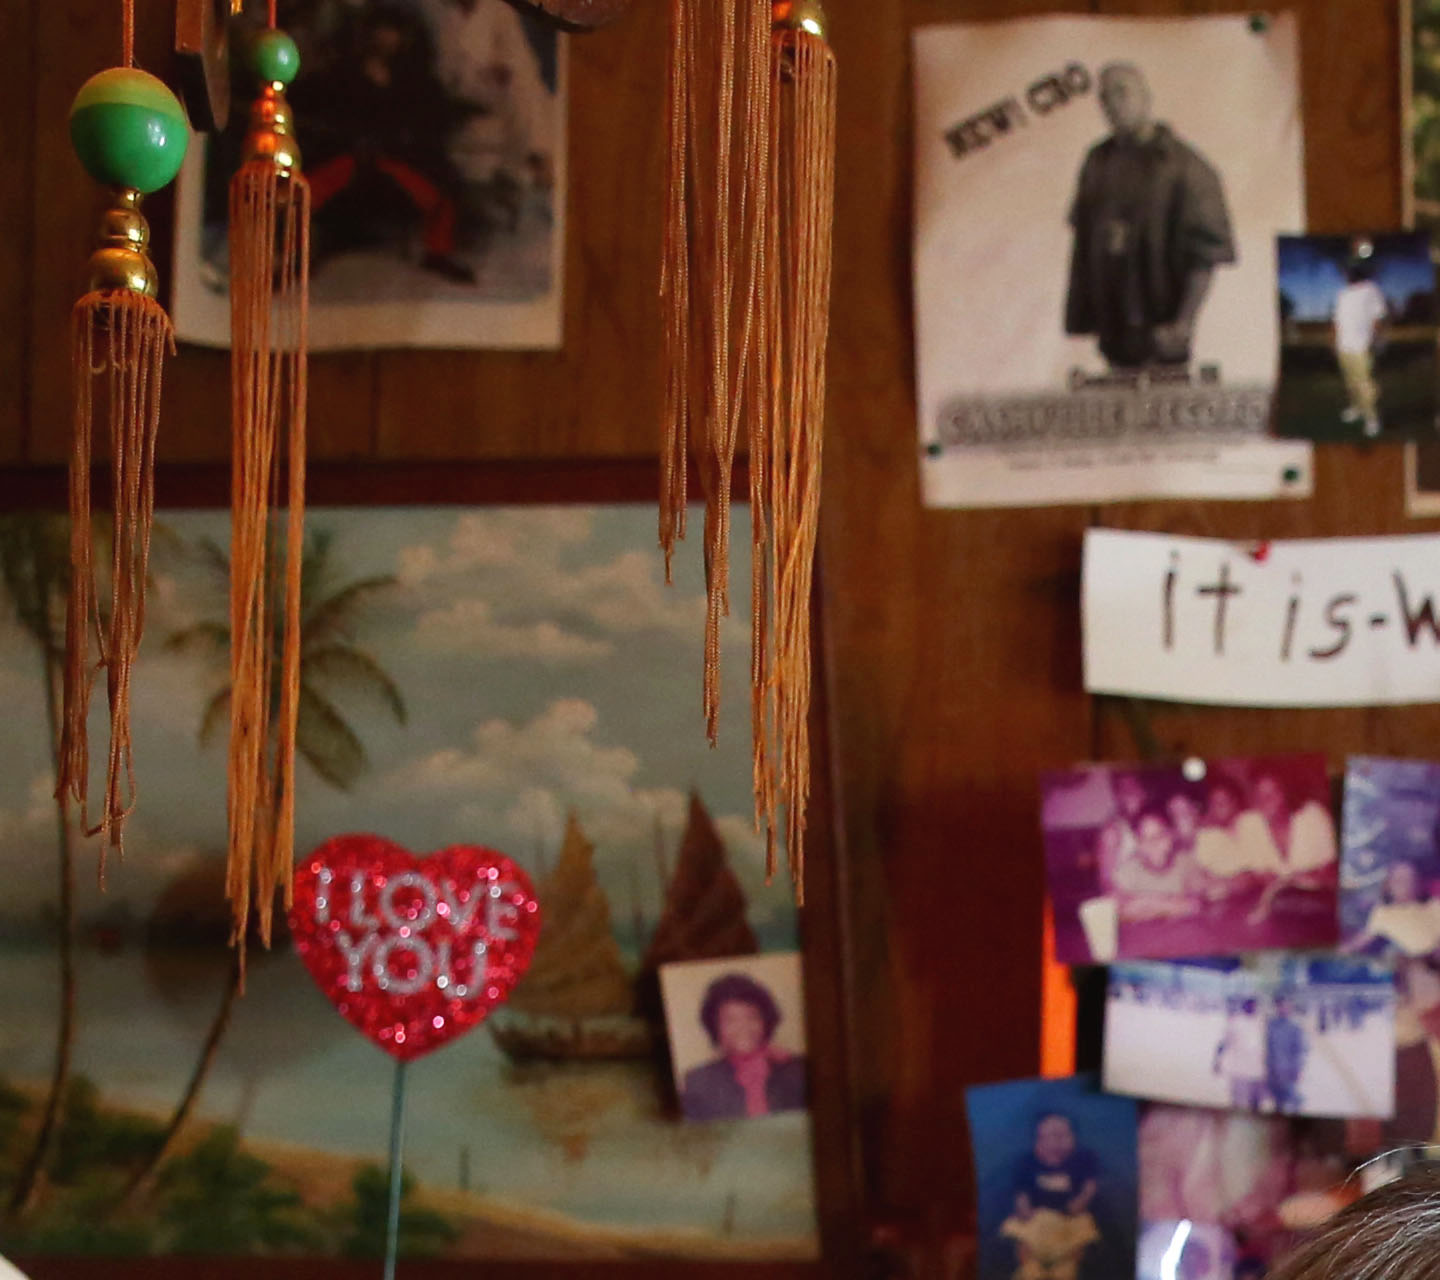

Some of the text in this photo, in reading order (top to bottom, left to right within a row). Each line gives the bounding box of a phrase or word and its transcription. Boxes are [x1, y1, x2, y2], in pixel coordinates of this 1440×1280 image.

[1162, 549, 1241, 655] it
[314, 866, 521, 942] I LOVE
[334, 929, 490, 1002] YOU
